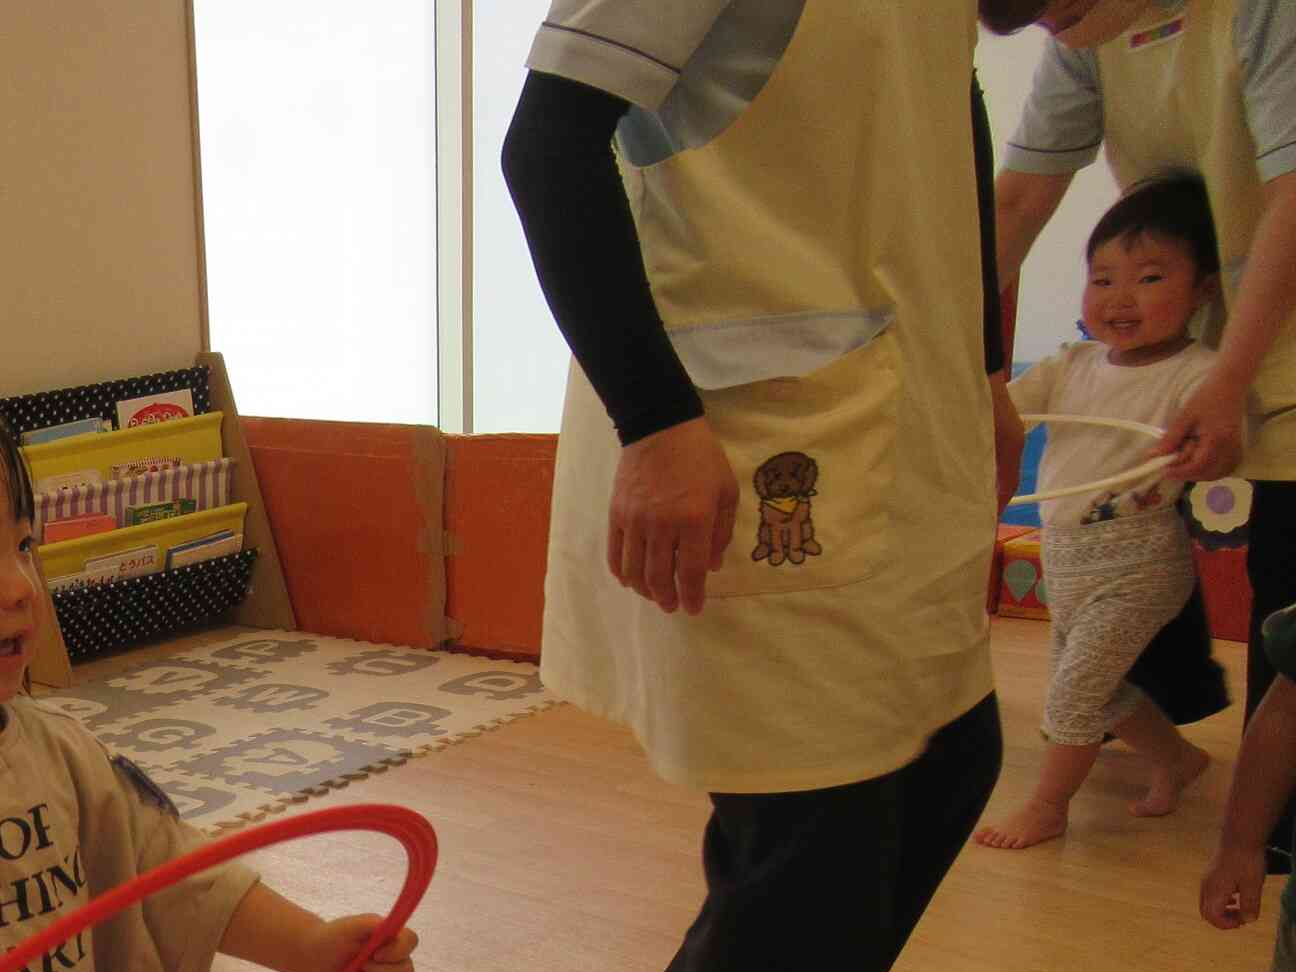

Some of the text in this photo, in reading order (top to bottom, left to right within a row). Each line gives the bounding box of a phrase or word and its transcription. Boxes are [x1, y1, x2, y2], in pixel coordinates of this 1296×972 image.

[463, 674, 530, 692] D
[360, 708, 434, 728] B
[137, 725, 197, 744] G
